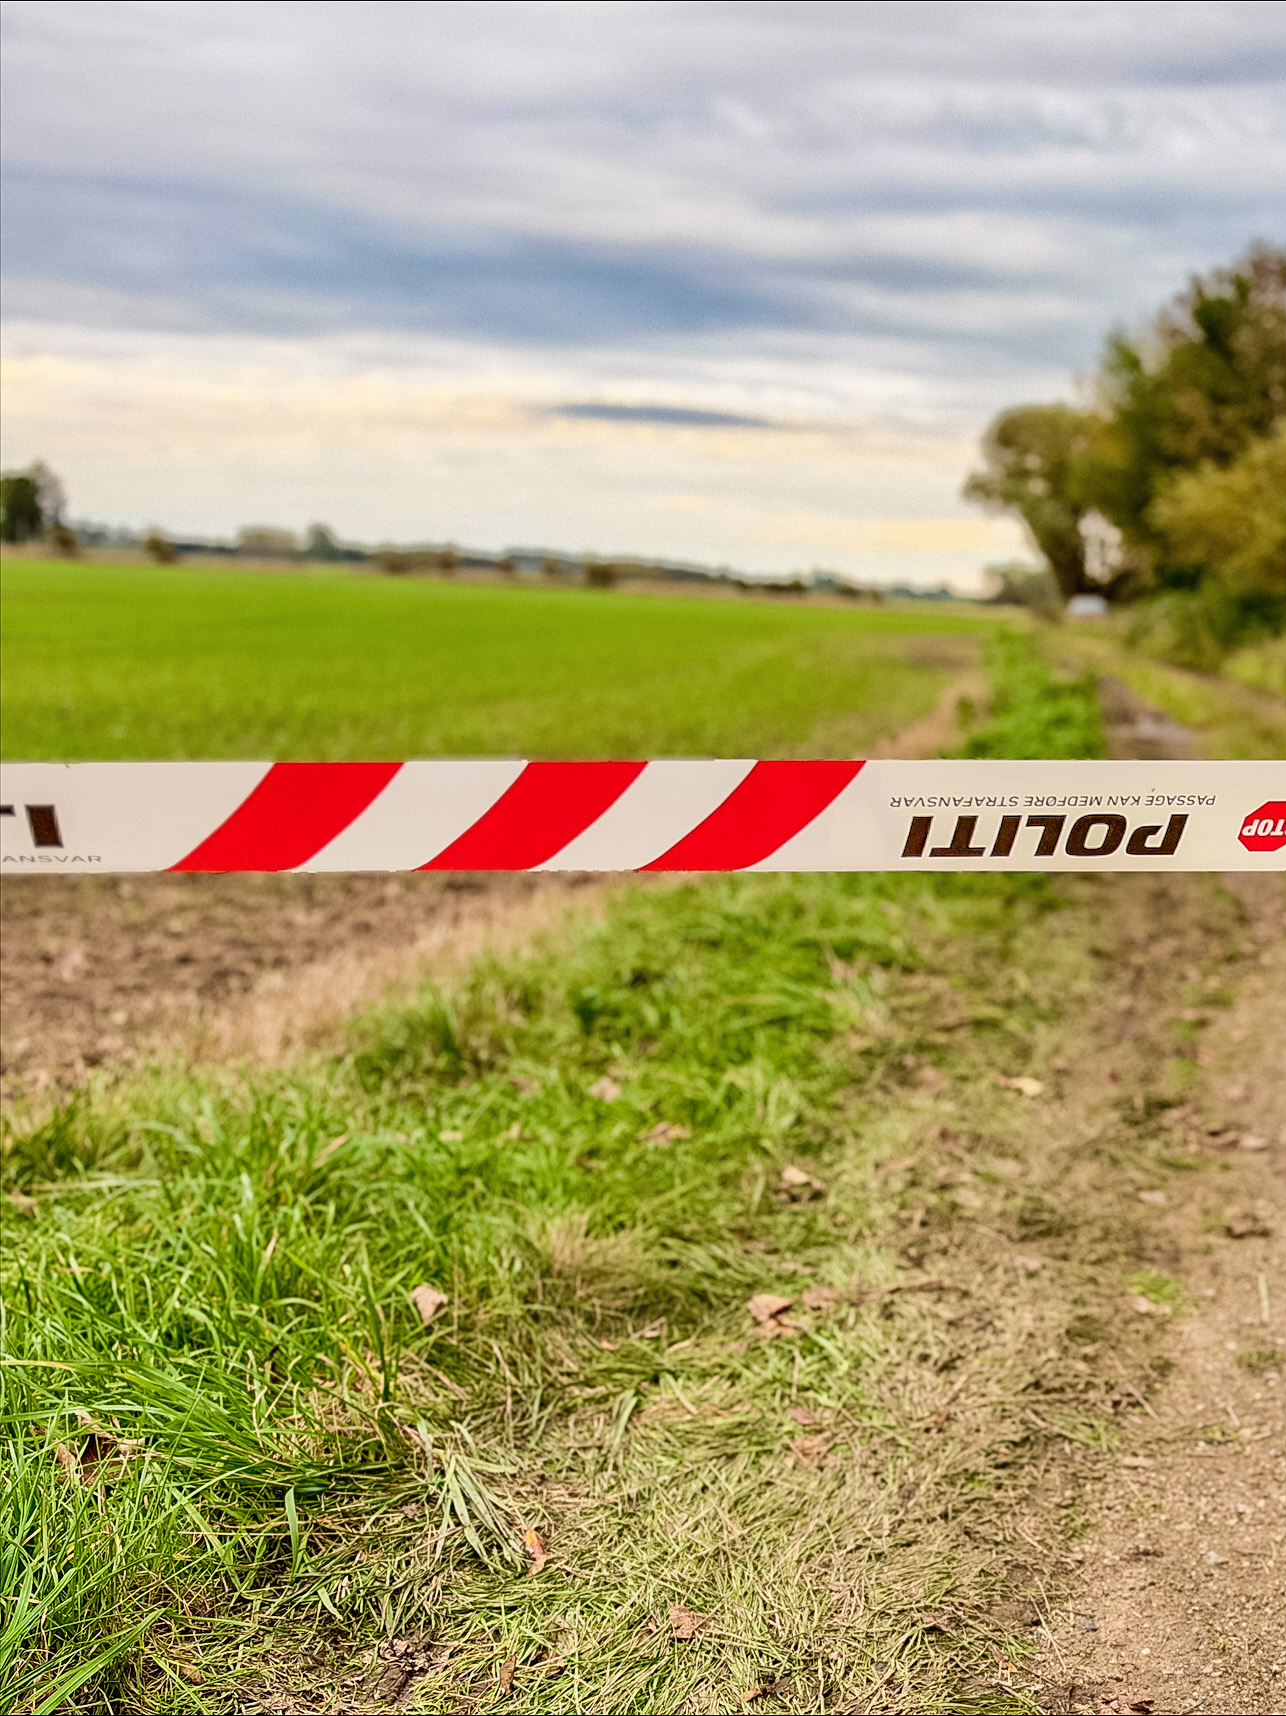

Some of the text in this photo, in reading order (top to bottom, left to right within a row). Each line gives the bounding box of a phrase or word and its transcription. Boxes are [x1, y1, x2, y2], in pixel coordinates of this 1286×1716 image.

[889, 795, 1216, 808] PASSAGE KAN MEDFØRE STRAFANSVAR
[900, 813, 1190, 858] POLITI
[2, 854, 103, 863] ANSVAR
